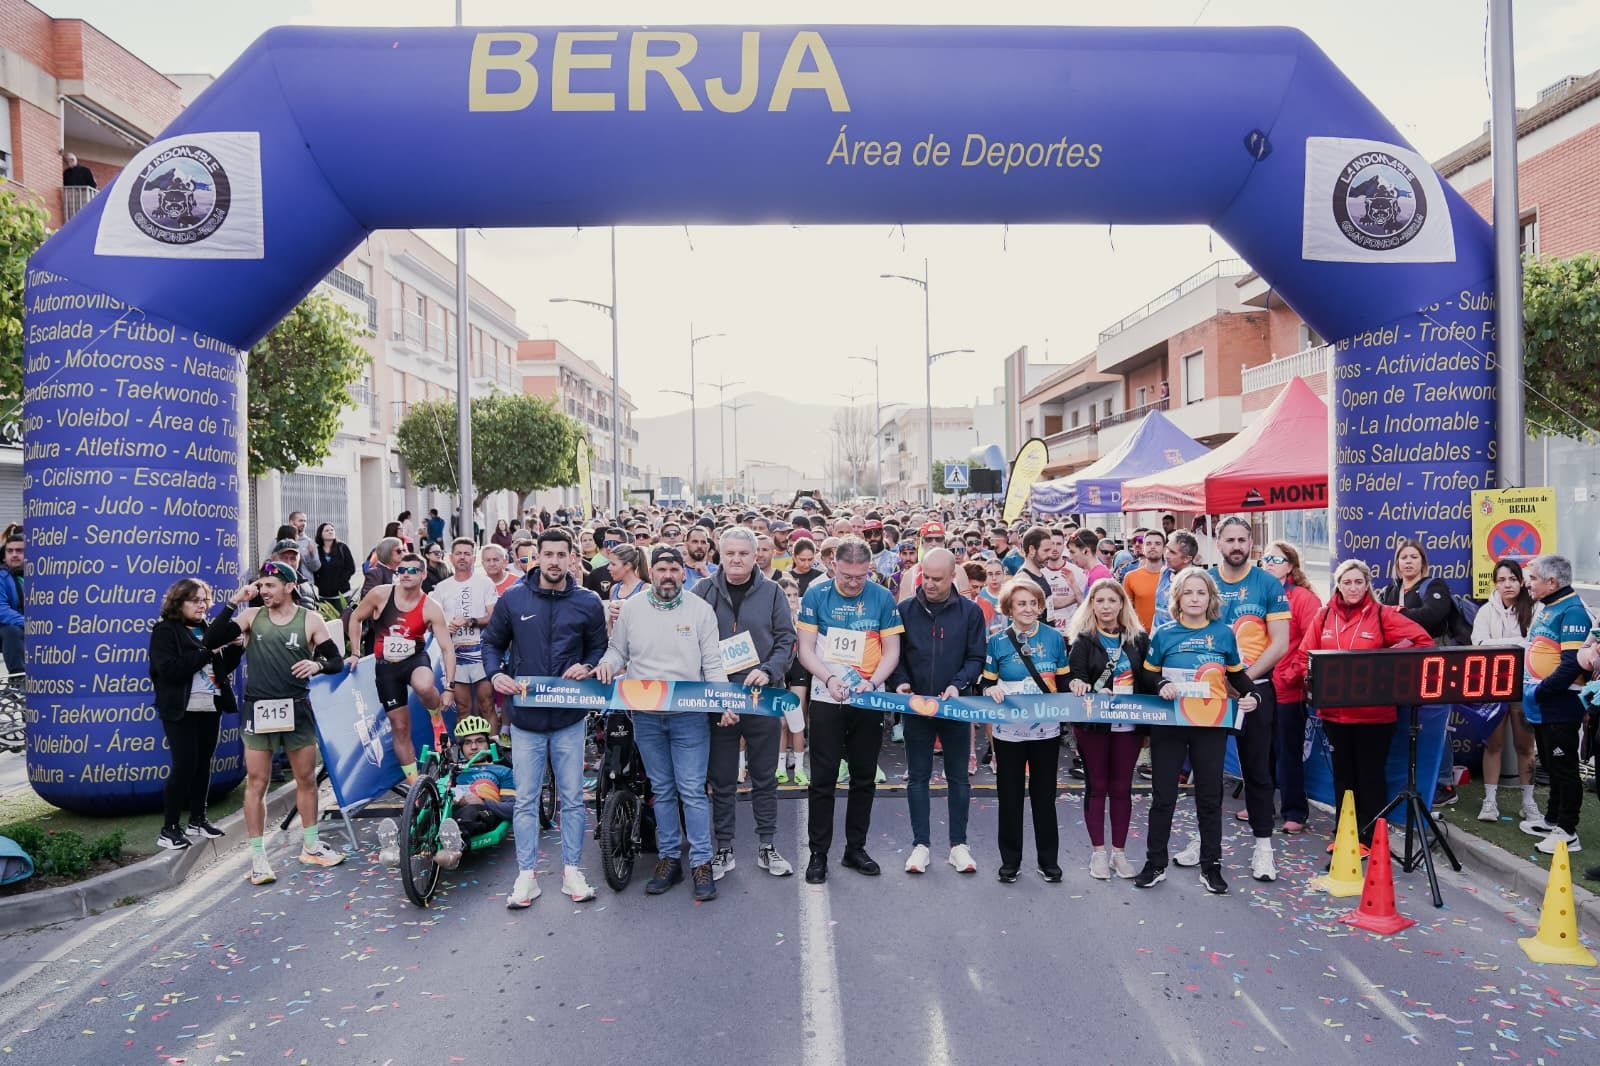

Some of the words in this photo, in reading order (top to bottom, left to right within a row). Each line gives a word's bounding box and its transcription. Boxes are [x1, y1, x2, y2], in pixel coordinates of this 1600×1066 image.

[468, 31, 851, 113] BERJA
[826, 125, 901, 167] Área
[912, 132, 951, 167] de
[961, 132, 1103, 175] Deportes
[1352, 153, 1415, 182] INDOMABLE
[29, 320, 93, 344] Escalada
[113, 319, 176, 344] Fútbol
[1419, 321, 1476, 342] Trofeo
[27, 352, 50, 374] Judo
[64, 348, 165, 371] Motocross
[1376, 351, 1480, 375] Actividades
[115, 378, 219, 406] Taekwondo
[1342, 388, 1378, 411] Open
[1383, 384, 1405, 404] de
[57, 408, 129, 427] Voleibol
[149, 405, 193, 431] Área
[199, 415, 217, 434] de
[1360, 415, 1379, 435] La
[1384, 411, 1479, 433] Indomable
[24, 440, 60, 461] Cultura
[76, 436, 167, 457] Atletismo
[1371, 442, 1471, 463] Saludables
[42, 467, 113, 487] Ciclismo
[134, 467, 217, 490] Escalada
[1339, 474, 1351, 492] de
[1355, 472, 1402, 492] Pádel
[1422, 471, 1479, 491] Trofeo
[94, 495, 144, 515] Judo
[1378, 501, 1472, 521] Actividade
[1497, 496, 1539, 505] Ayuntamiento
[1509, 504, 1536, 514] BERJA
[32, 526, 69, 547] Pádel
[85, 524, 200, 546] Senderismo
[1344, 530, 1379, 552] Open
[127, 555, 201, 574] Voleibol
[29, 582, 54, 605] Área
[58, 585, 79, 605] de
[85, 585, 156, 605] Cultura
[67, 614, 163, 635] Balonces
[34, 644, 77, 665] Fútbol
[95, 643, 150, 664] Gimn
[389, 643, 409, 653] 223
[721, 641, 751, 661] 1068
[834, 637, 857, 652] 191
[1420, 654, 1516, 698] 0:00
[535, 683, 546, 693] IV
[704, 688, 714, 698] IV
[535, 694, 565, 704] CIUDAD
[567, 695, 578, 704] DE
[579, 695, 606, 705] BERJA
[678, 698, 708, 708] CIUDAD
[709, 699, 721, 708] DE
[722, 699, 746, 709] BERJA
[1100, 700, 1110, 710] IV
[50, 703, 156, 724] Taekwondo
[261, 706, 288, 720] 415
[1100, 711, 1129, 720] CIUDAD
[1130, 711, 1141, 720] DE
[1142, 712, 1167, 721] BERJA
[34, 734, 89, 754] Voleibol
[106, 729, 155, 752] Área
[28, 763, 64, 783] Cultura
[80, 763, 171, 784] Atletismo
